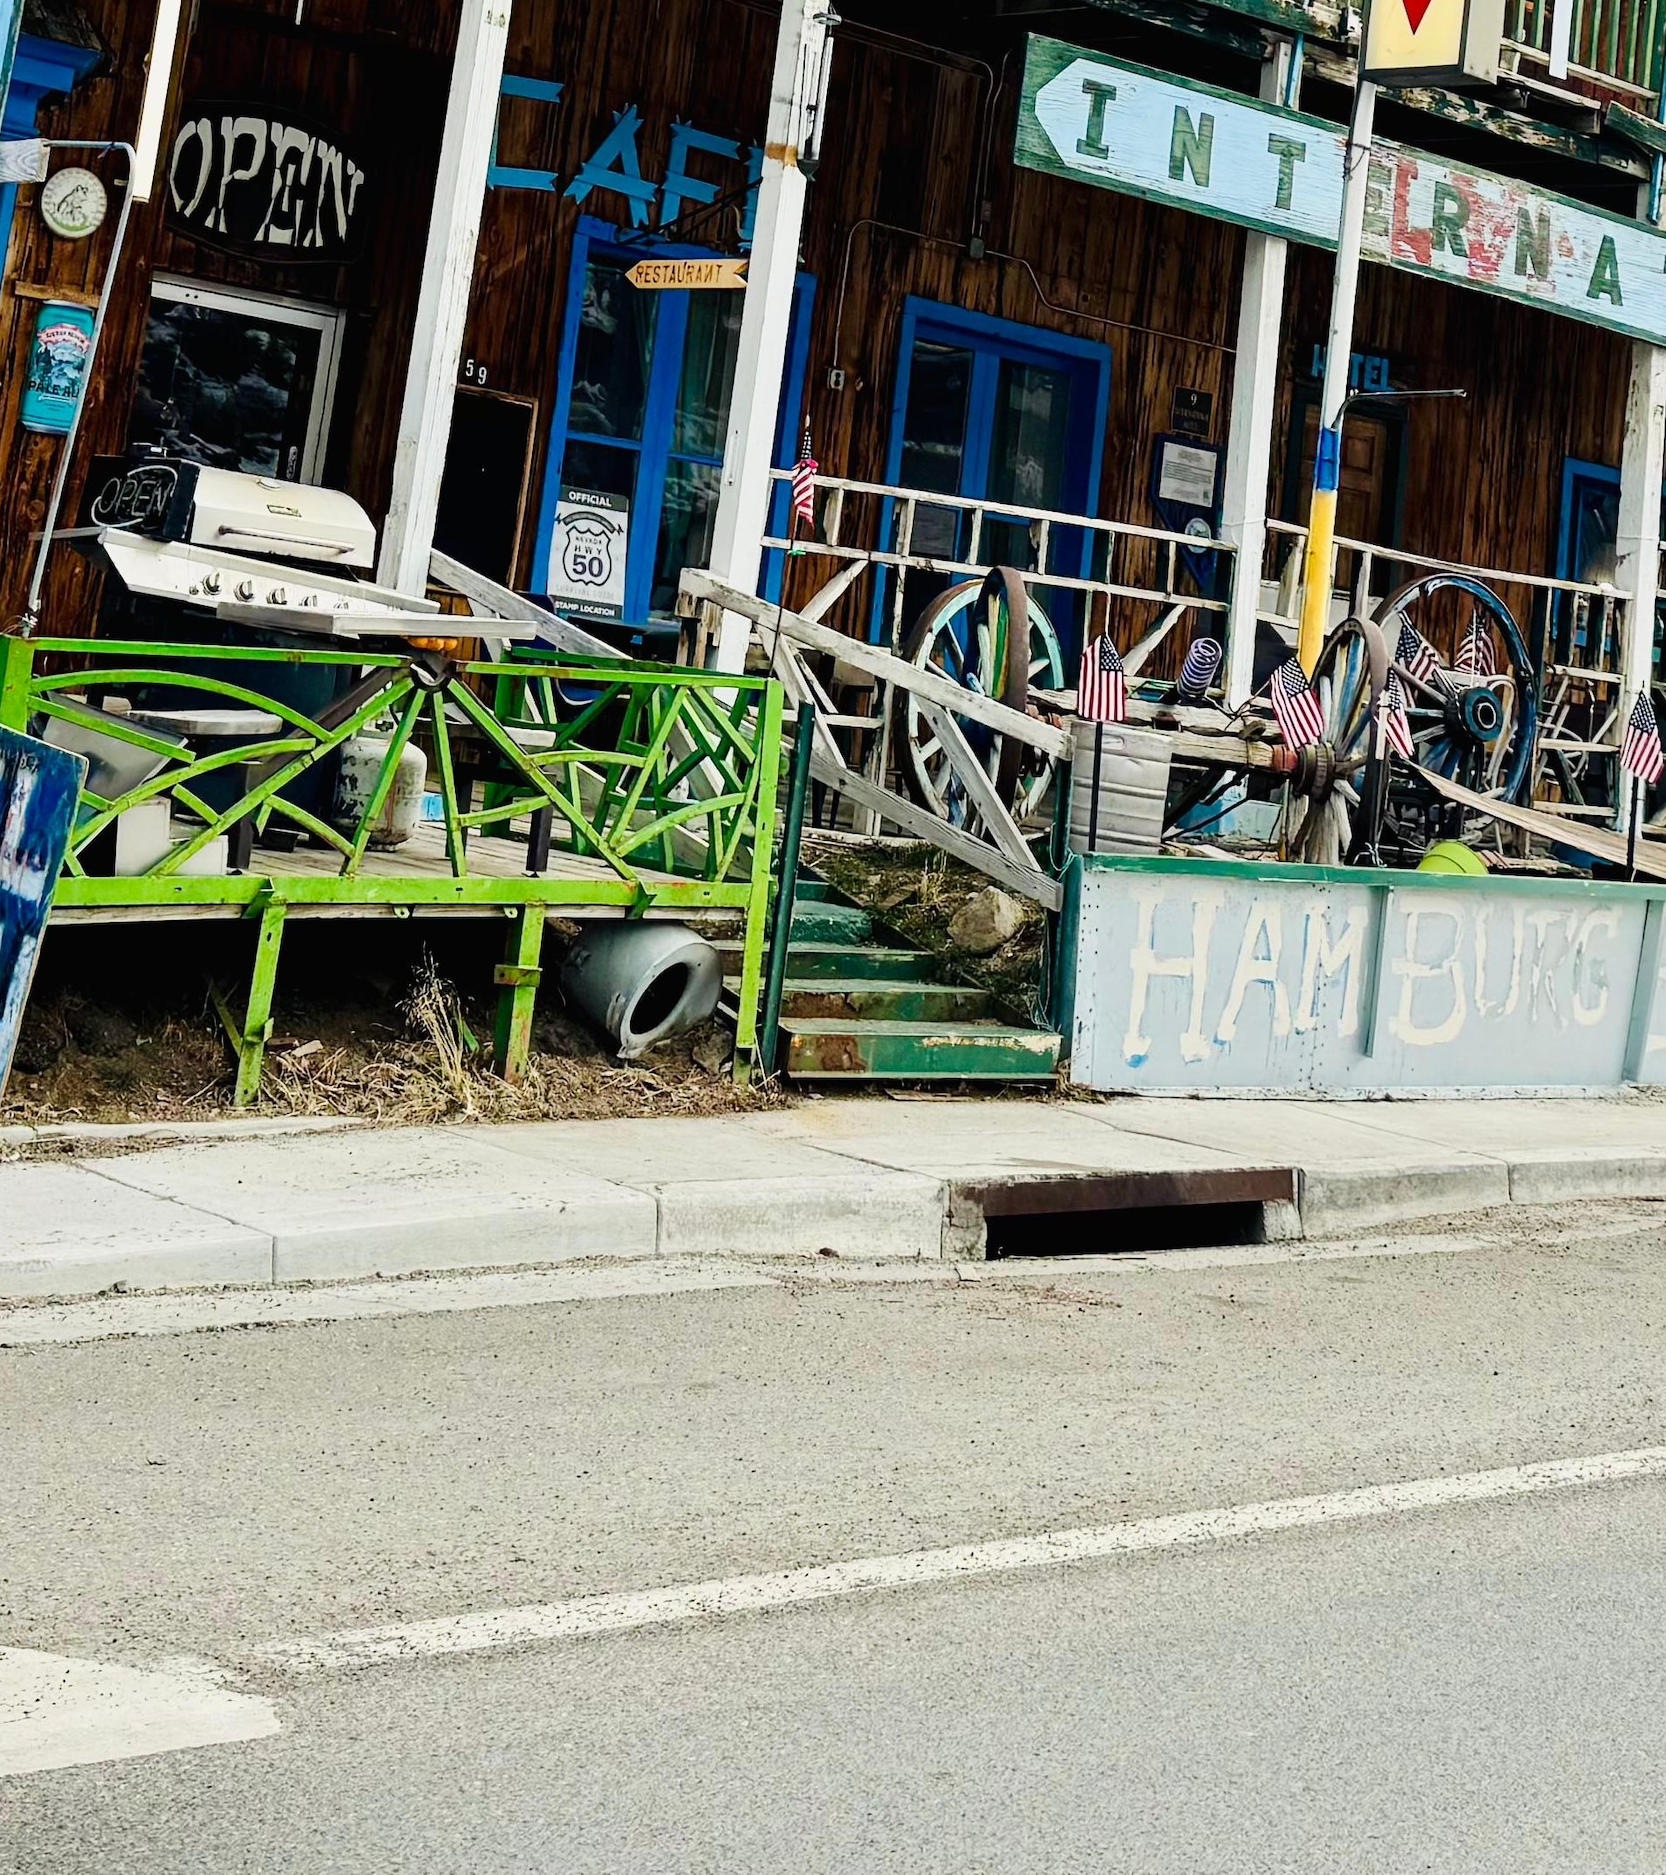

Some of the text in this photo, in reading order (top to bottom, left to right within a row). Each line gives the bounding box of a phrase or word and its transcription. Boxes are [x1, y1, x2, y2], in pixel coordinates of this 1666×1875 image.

[169, 116, 365, 248] OPEN
[635, 261, 723, 284] RESTAURANT
[465, 358, 488, 385] 59
[1311, 344, 1398, 393] HTEL
[28, 380, 61, 396] PALE
[98, 477, 173, 516] OPEN
[568, 491, 612, 507] OFFICIAL
[574, 544, 603, 556] HWY
[575, 536, 603, 546] NEVADA
[572, 553, 604, 578] 50
[554, 600, 615, 617] STAMP LOCATION
